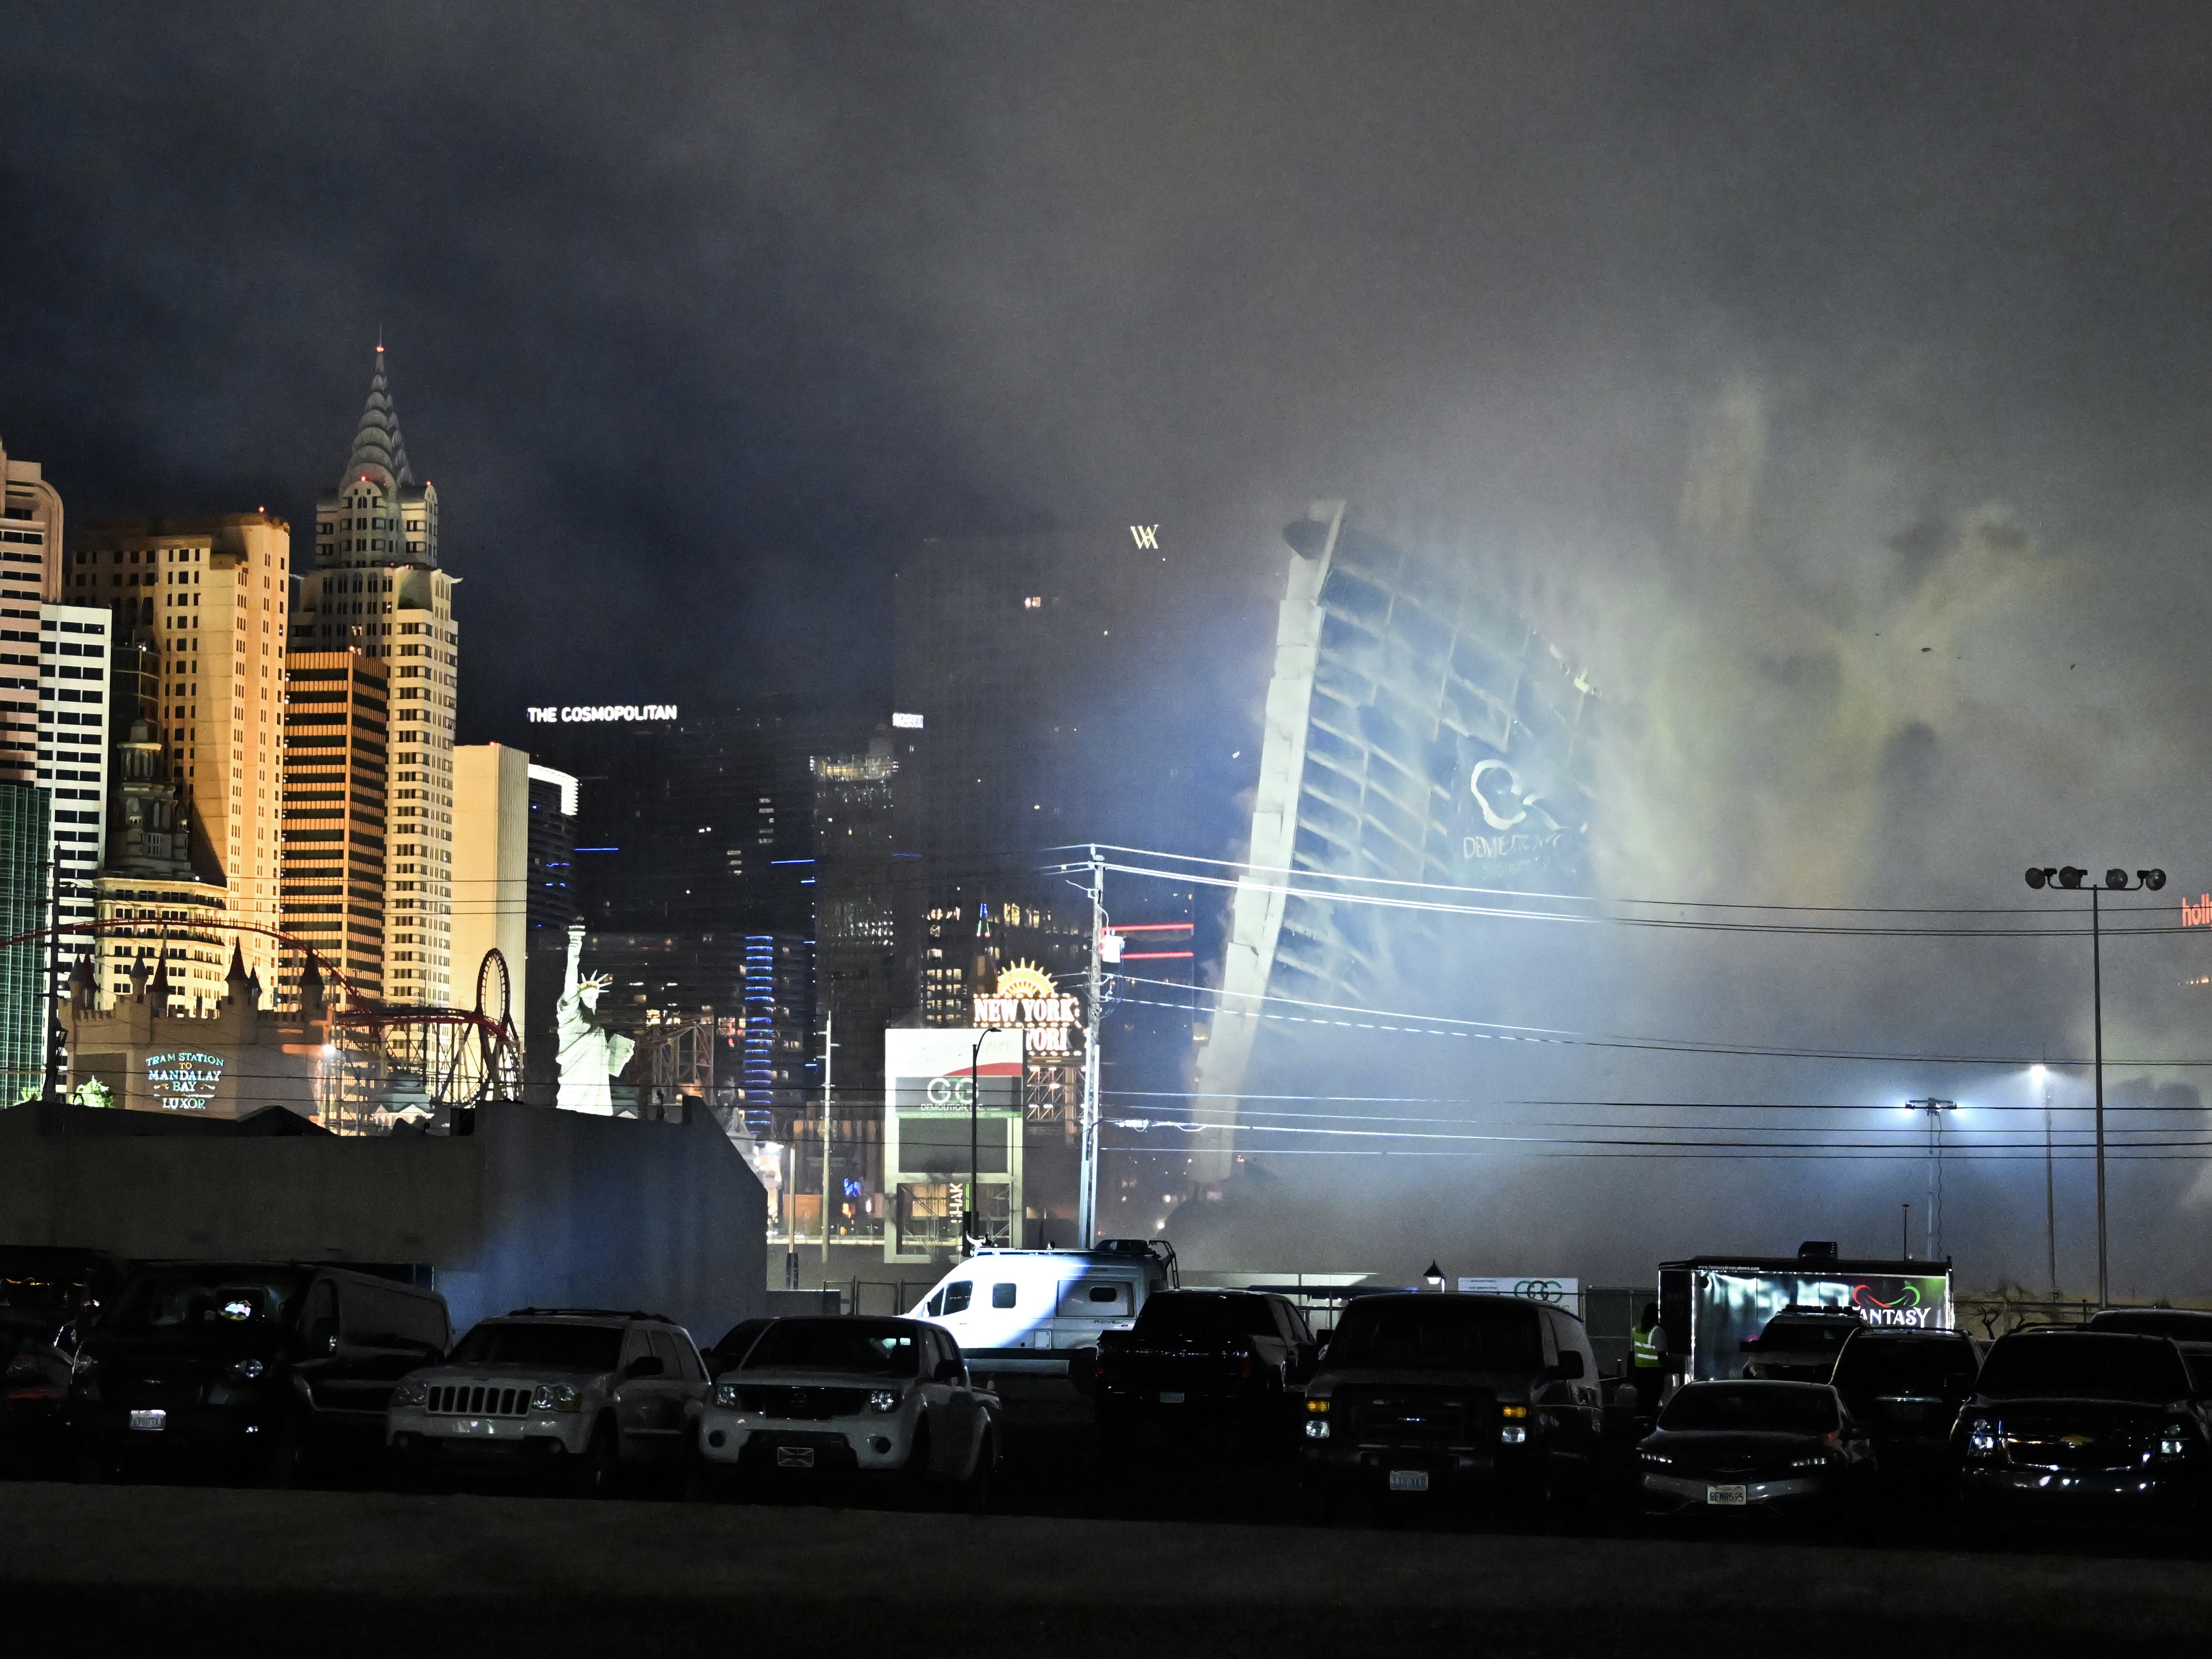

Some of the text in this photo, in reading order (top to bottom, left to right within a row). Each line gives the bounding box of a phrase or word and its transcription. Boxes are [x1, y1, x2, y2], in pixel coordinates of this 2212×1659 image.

[527, 705, 677, 722] THE COSMOPOLITAN
[2182, 893, 2212, 930] holl
[974, 998, 1075, 1022] NEW YORK
[146, 1052, 224, 1067] TRAM STATION
[149, 1070, 221, 1082] MANDALAY
[172, 1081, 197, 1092] BAY
[163, 1097, 206, 1110] LUXOR
[1852, 1305, 1931, 1328] ANTASY
